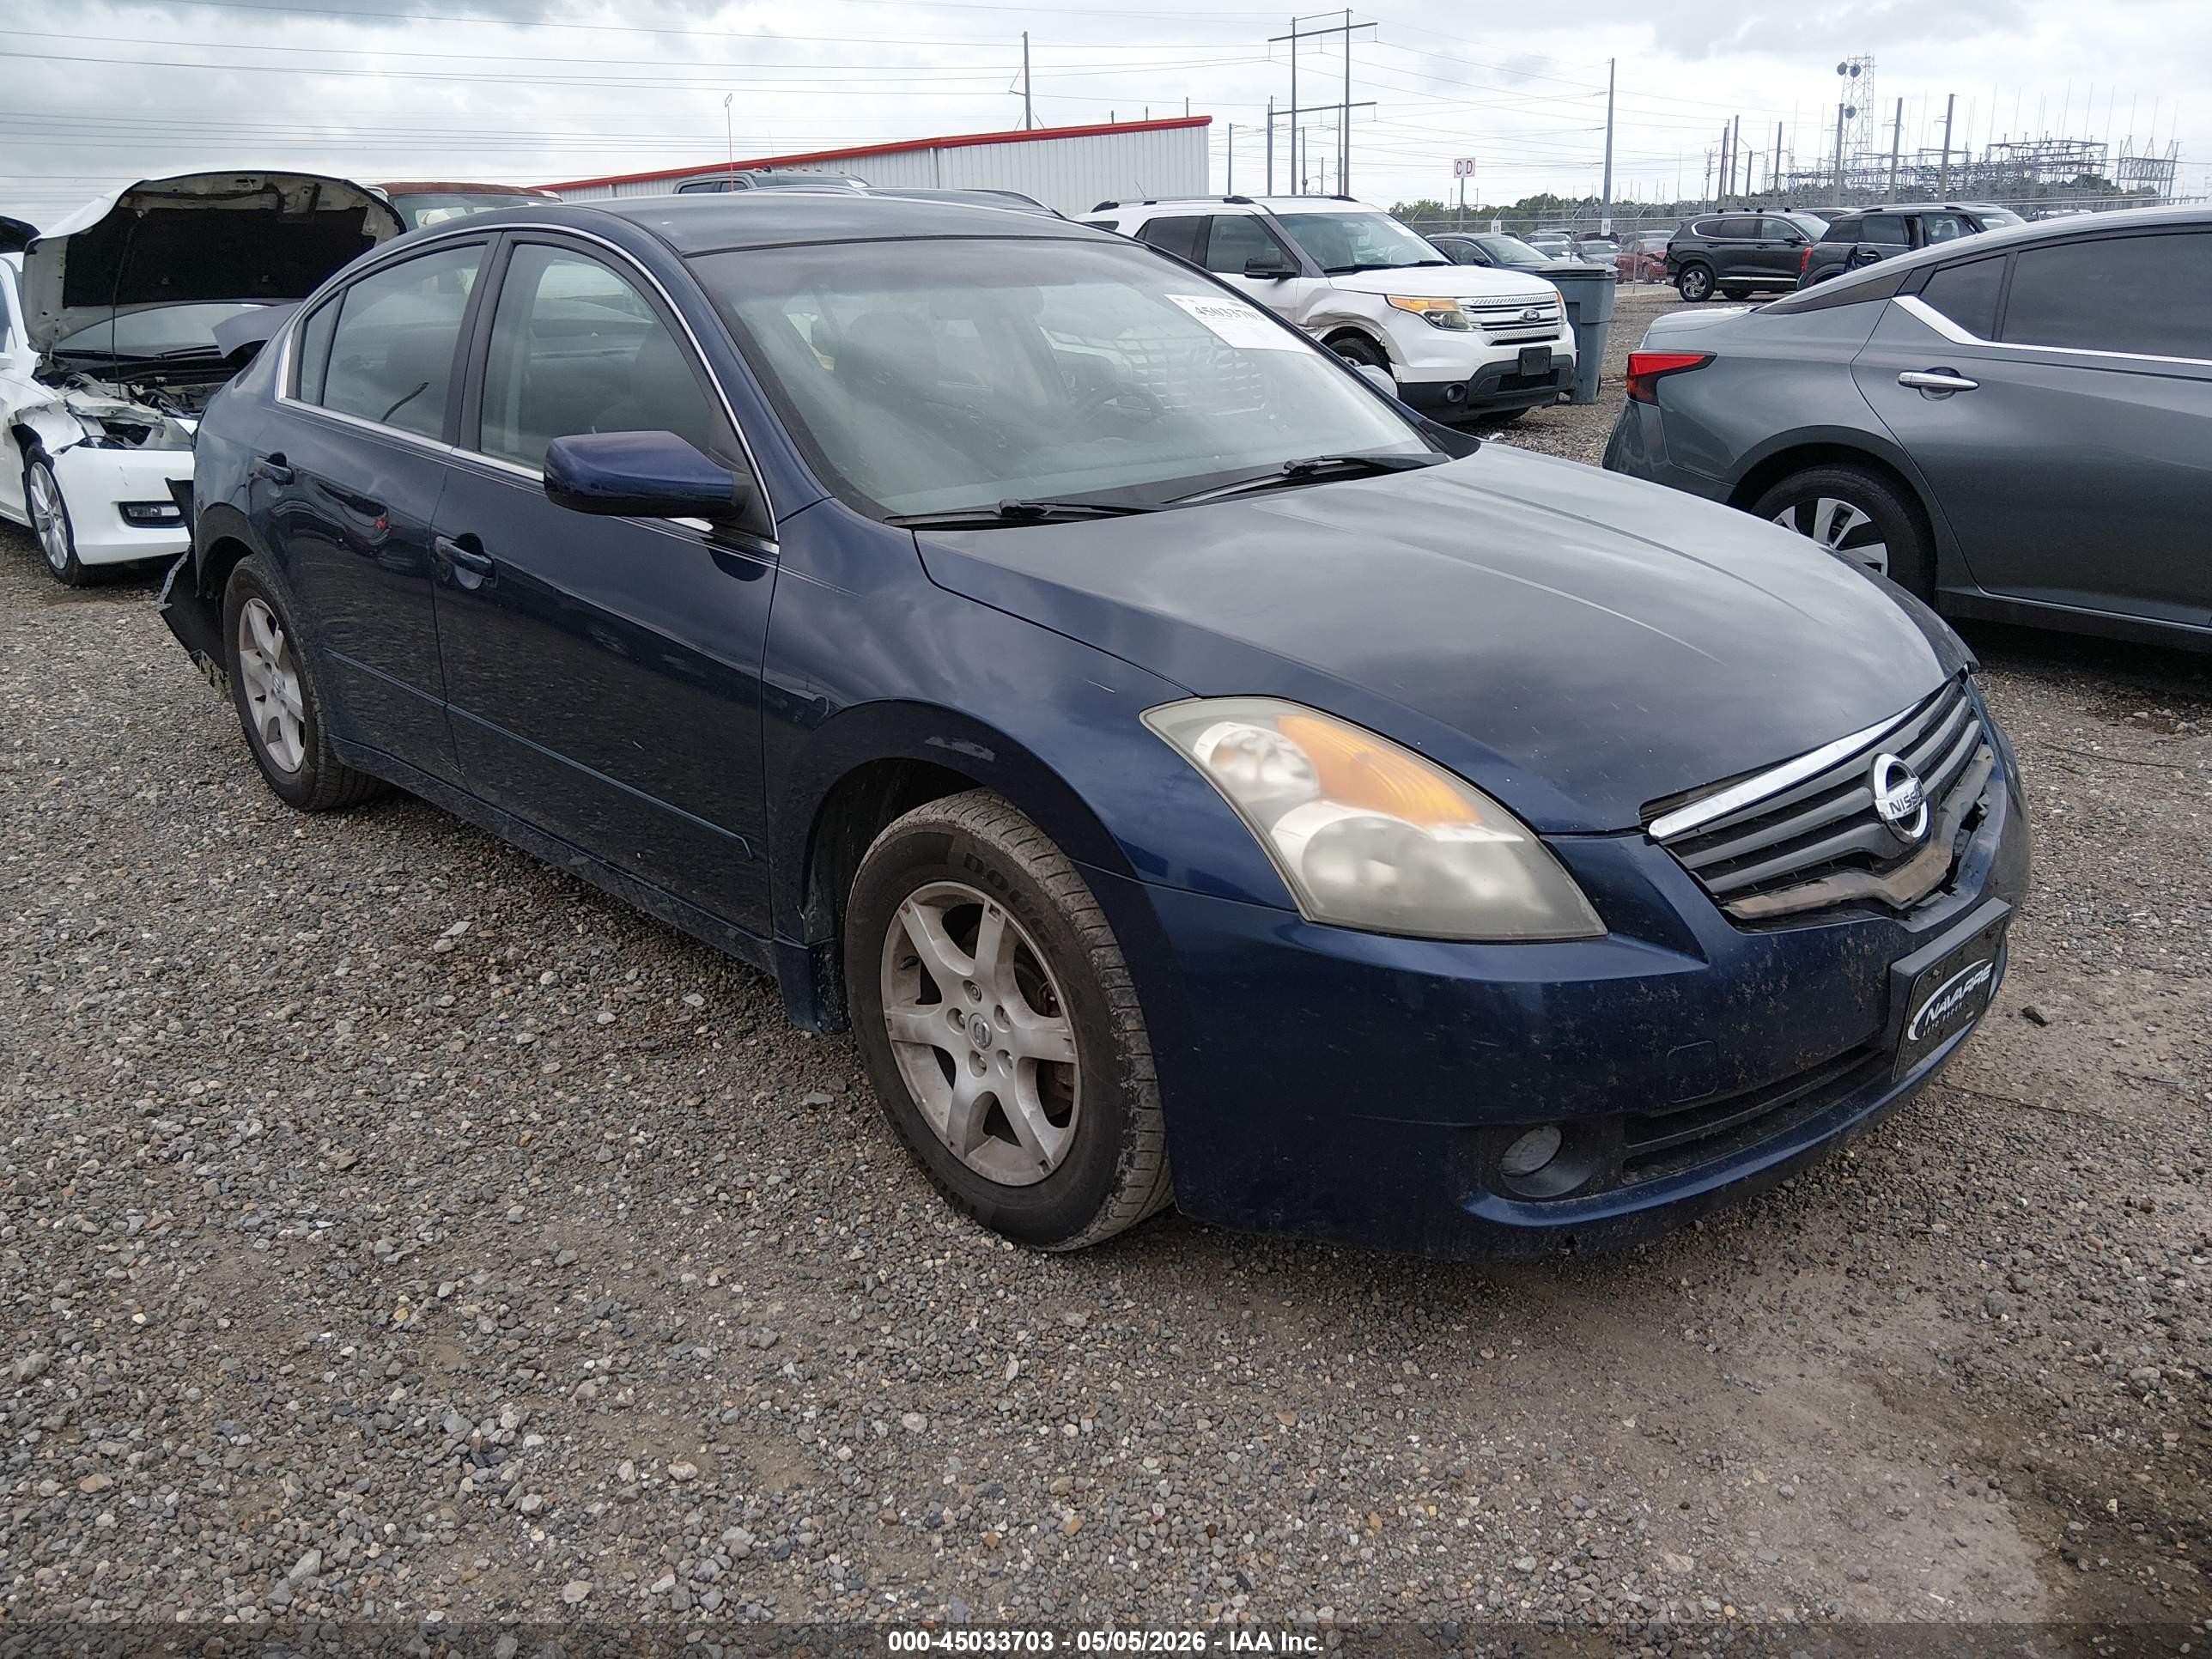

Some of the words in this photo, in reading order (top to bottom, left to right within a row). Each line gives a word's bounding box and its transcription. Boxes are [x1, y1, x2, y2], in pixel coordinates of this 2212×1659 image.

[1456, 161, 1462, 174] C
[1467, 160, 1473, 174] D
[1925, 962, 1994, 1026] NAVARRE
